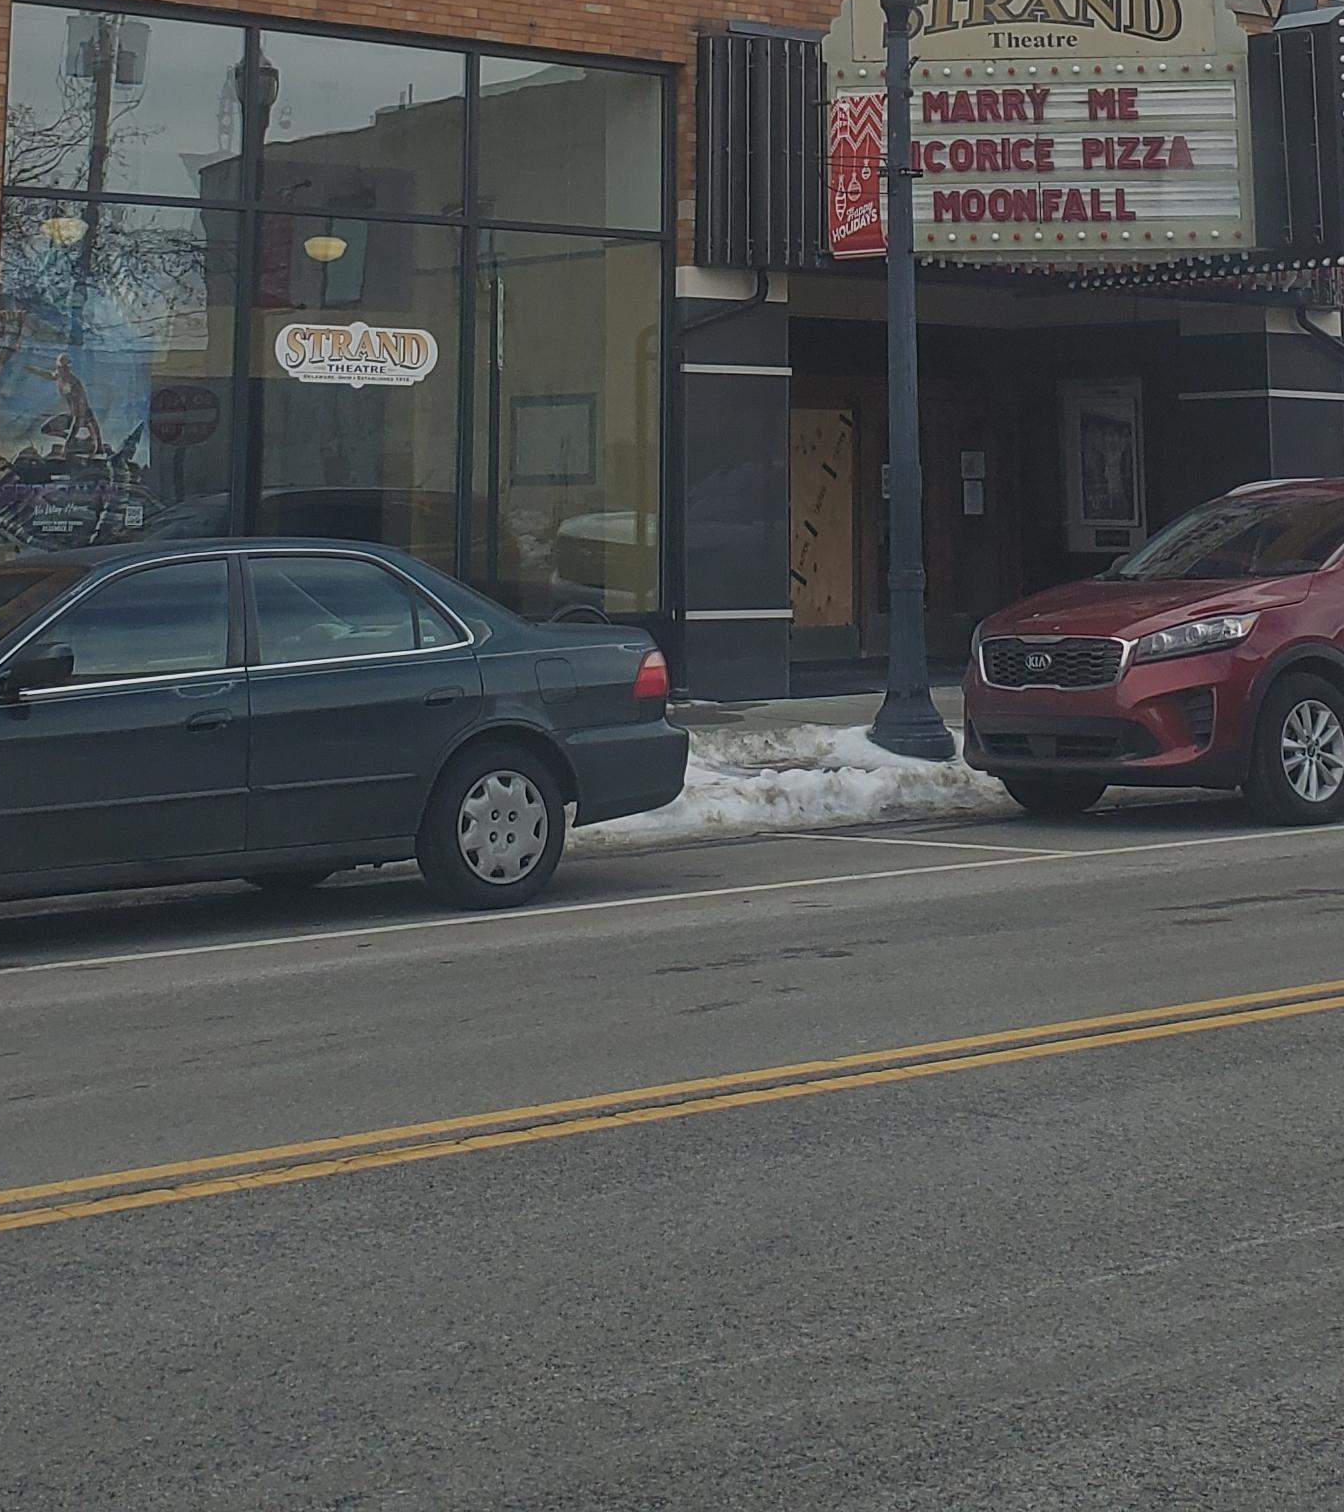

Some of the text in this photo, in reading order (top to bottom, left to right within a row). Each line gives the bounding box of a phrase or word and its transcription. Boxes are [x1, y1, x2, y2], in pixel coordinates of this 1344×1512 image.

[988, 32, 1078, 49] Theatre
[922, 88, 1139, 122] MARRY ME
[911, 136, 1194, 172] ICORICE PIZZA
[933, 188, 1136, 223] MOONFALL
[831, 208, 879, 243] HOLIDAYS
[286, 328, 428, 369] STRAND
[327, 364, 386, 374] THEATRE
[1027, 653, 1047, 670] KIA
